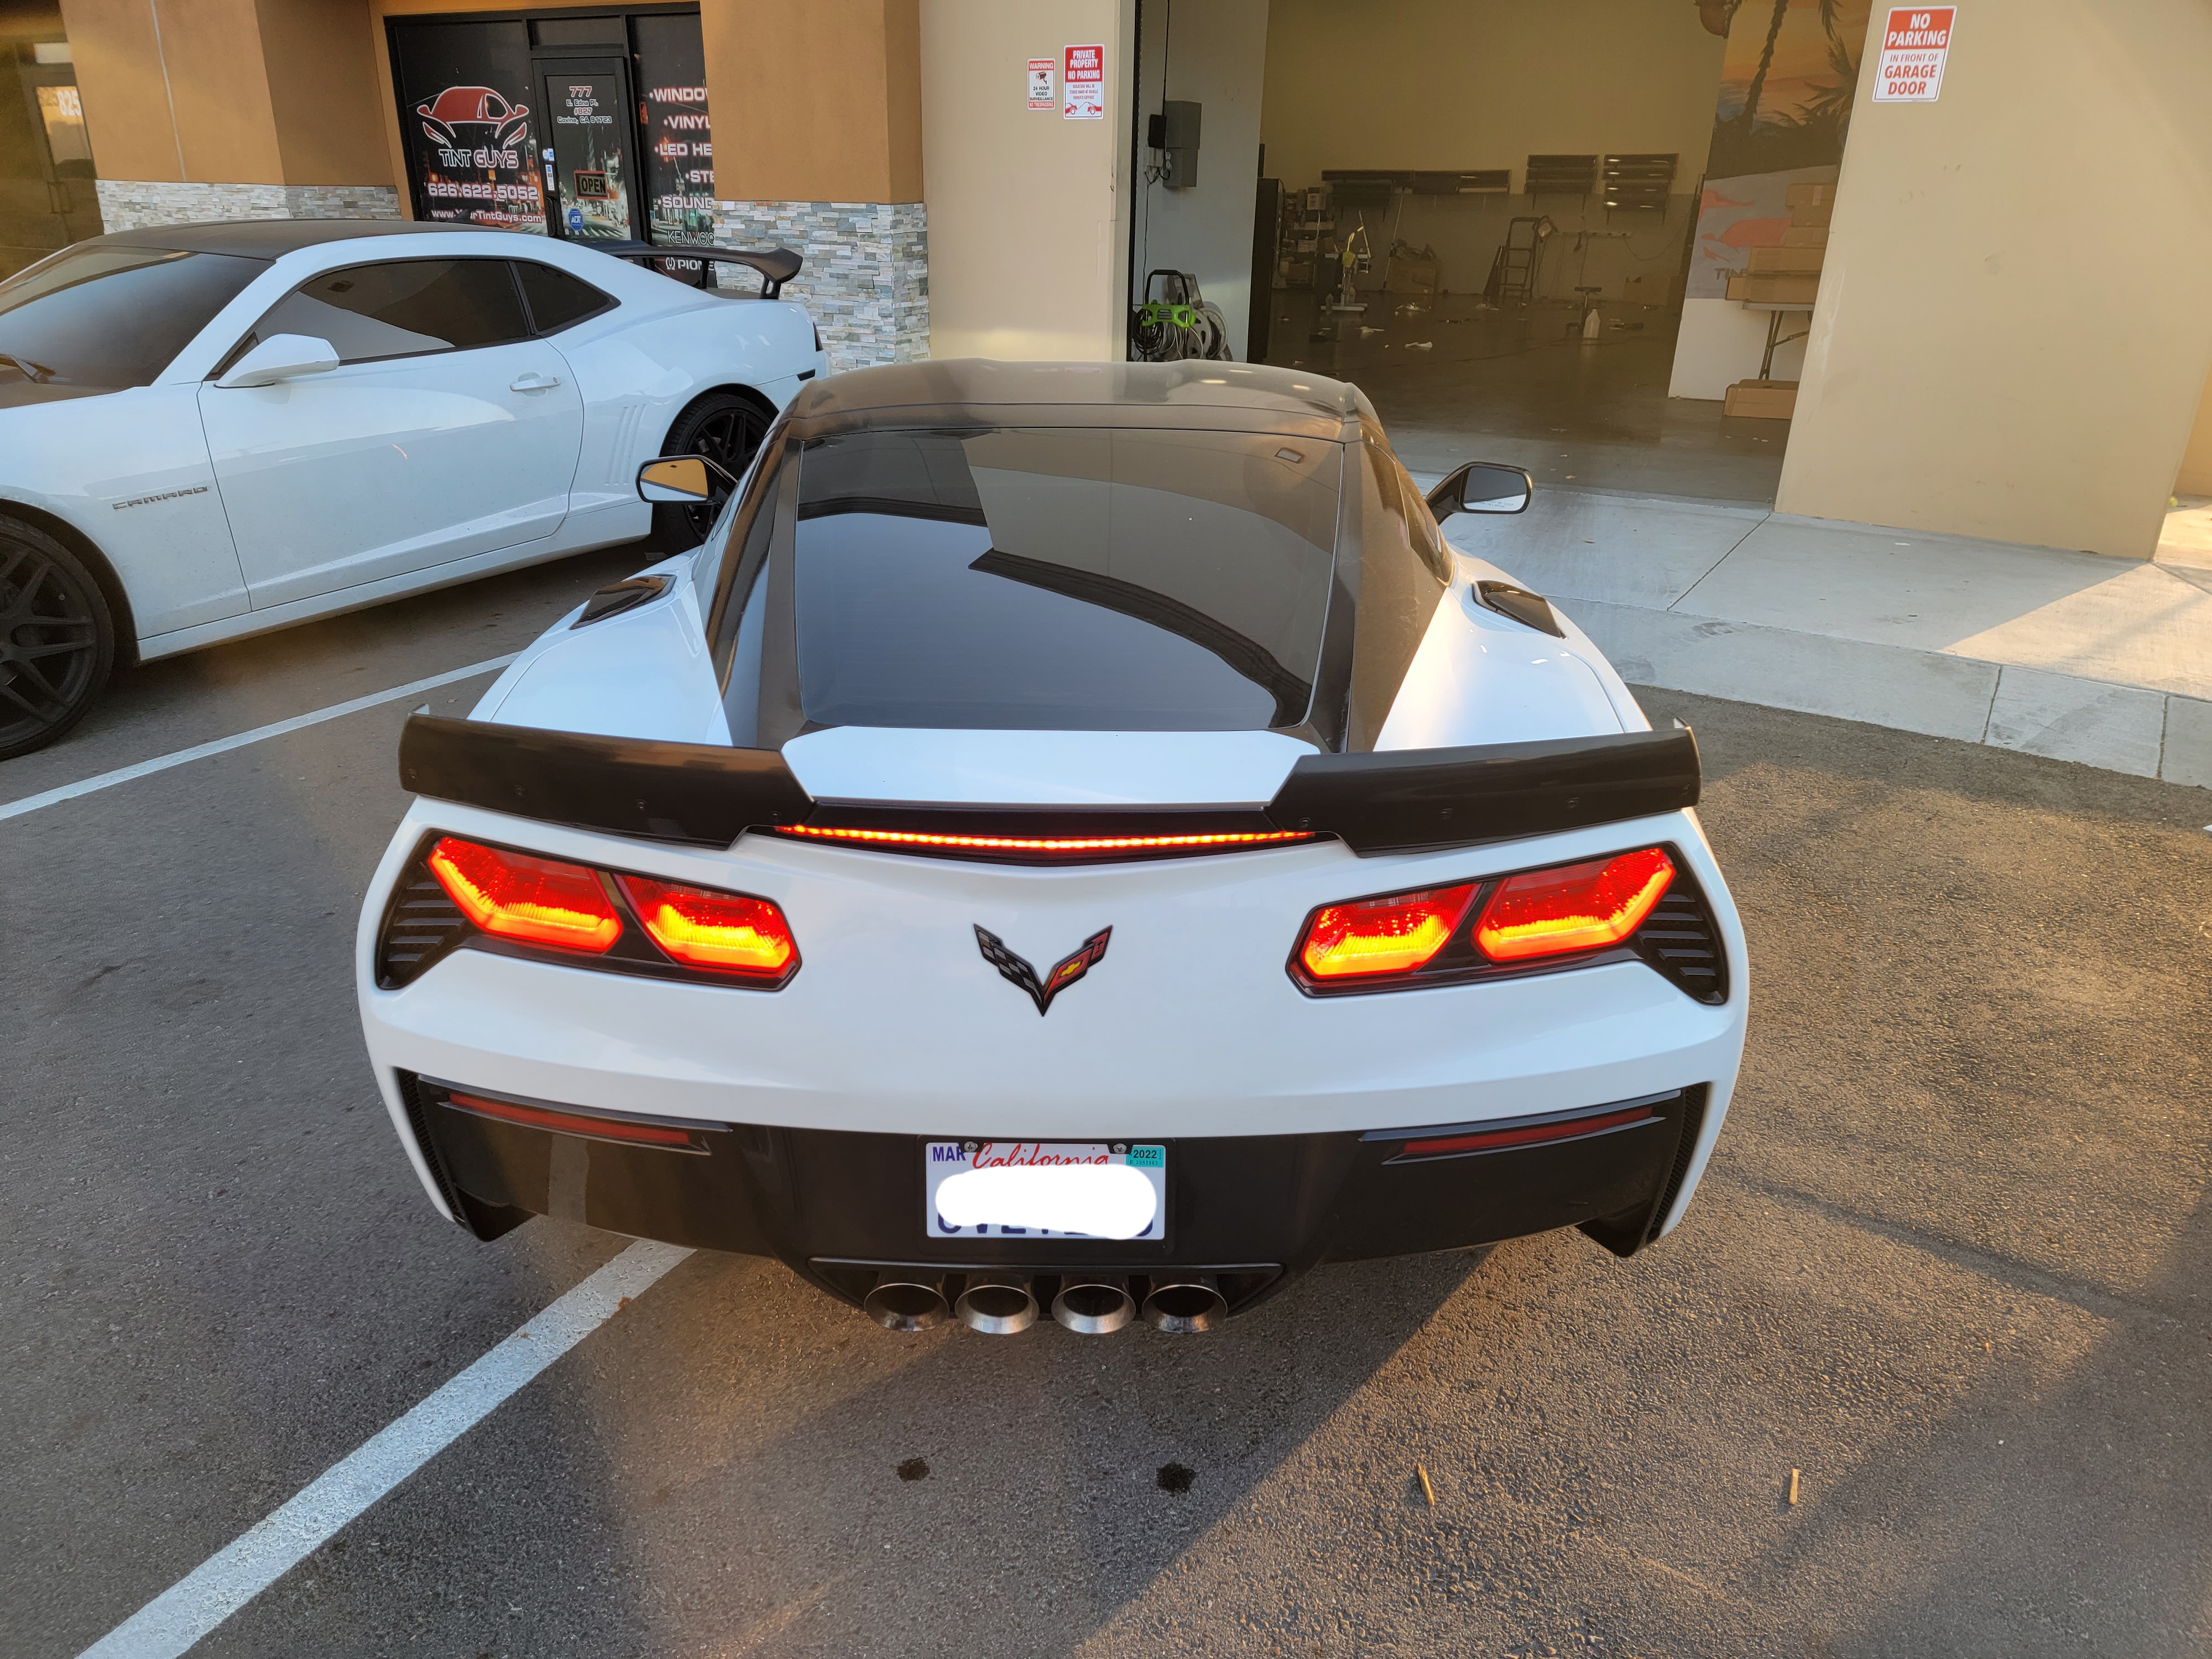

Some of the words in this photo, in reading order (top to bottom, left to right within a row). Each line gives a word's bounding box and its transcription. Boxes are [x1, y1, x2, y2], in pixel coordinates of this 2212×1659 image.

[1910, 13, 1931, 29] NO
[1887, 29, 1947, 46] PARKING
[1073, 50, 1095, 59] PRIVATE
[1890, 54, 1899, 62] IN
[1901, 53, 1927, 62] FRONT
[1928, 53, 1939, 61] OF
[1070, 58, 1098, 68] PROPERTY
[1068, 71, 1076, 80] NO
[1077, 70, 1100, 79] PARKING
[1885, 65, 1938, 79] GARAGE
[569, 86, 592, 97] 777
[653, 87, 708, 102] WINDO
[1887, 81, 1927, 95] DOOR
[557, 116, 578, 124] Covina,
[660, 143, 688, 155] LED
[692, 143, 712, 155] HE
[439, 149, 471, 167] TINT
[473, 149, 519, 168] GUYS
[428, 183, 539, 200] 626.622.5052
[581, 178, 606, 193] OPEN
[662, 196, 714, 209] SOUND
[431, 209, 542, 223] www.YurTintGuys.com
[112, 486, 208, 509] CAMARO
[932, 1146, 966, 1162] MAR
[972, 1142, 1109, 1169] California
[1133, 1150, 1157, 1159] 2022
